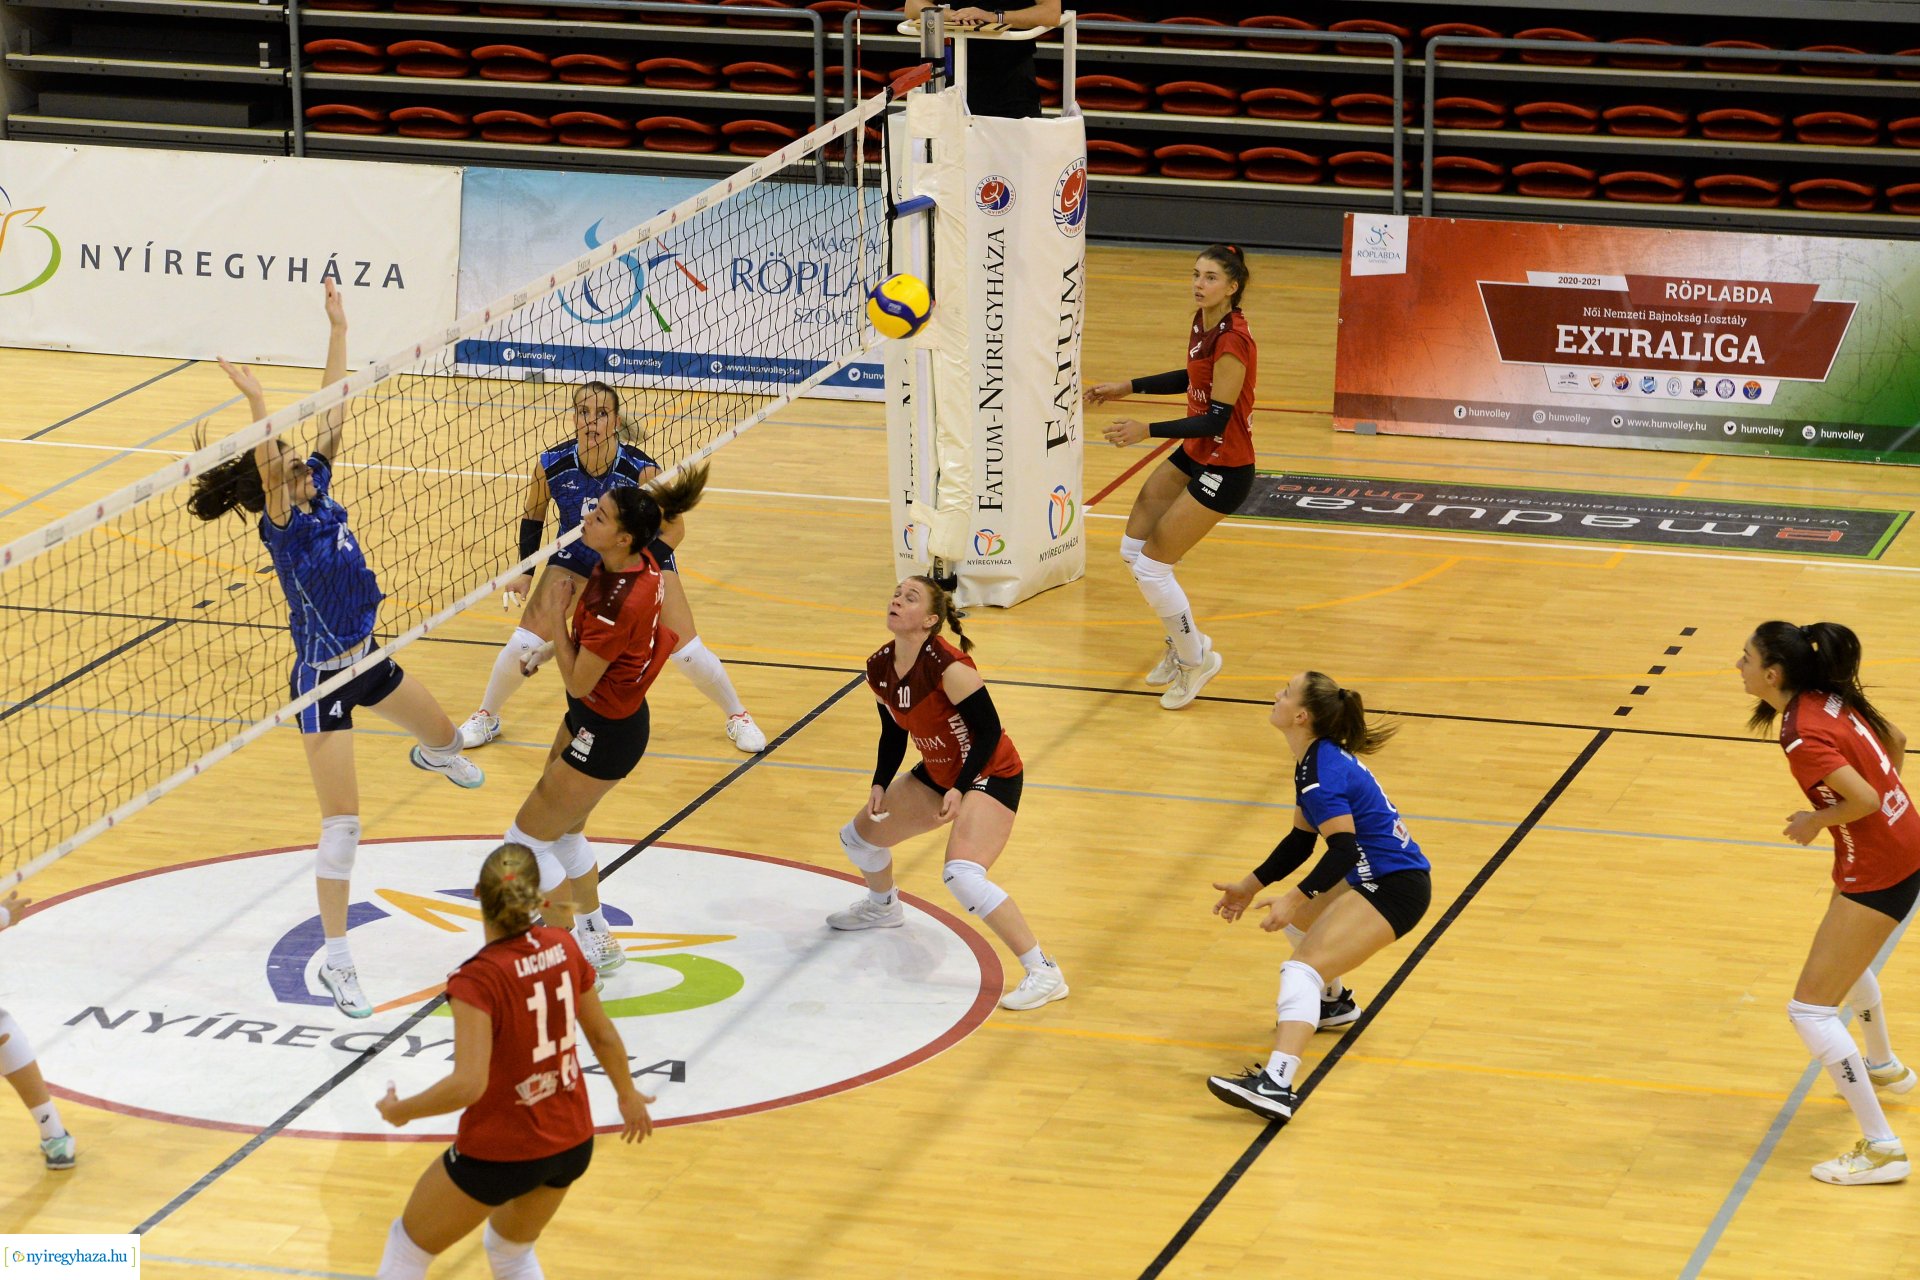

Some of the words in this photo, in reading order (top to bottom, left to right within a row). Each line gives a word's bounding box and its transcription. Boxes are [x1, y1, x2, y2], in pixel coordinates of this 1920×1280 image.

[80, 240, 405, 290] NYÍREGYHÁZA
[1557, 275, 1601, 286] 2020-2021
[1665, 280, 1774, 305] RÖPLABDA
[1583, 306, 1601, 317] Női
[1603, 308, 1646, 321] Nemzeti
[1648, 310, 1702, 325] Bajnokság
[1704, 314, 1747, 327] I.osztály
[1555, 323, 1765, 365] EXTRALIGA
[516, 350, 557, 363] hunvolley
[622, 356, 664, 368] hunvolley
[1046, 261, 1079, 458] FATUM
[1468, 407, 1511, 420] hunvolley
[1548, 412, 1591, 425] hunvolley
[1627, 417, 1707, 433] www.hunvolley.hu
[1740, 424, 1784, 437] hunvolley
[1820, 429, 1865, 442] hunvolley
[1277, 483, 1425, 502] Online
[1038, 536, 1080, 563] NYÍREGYHÁZA
[967, 558, 1012, 566] NYÍREGYHÁZA
[897, 685, 911, 708] 10
[328, 700, 344, 718] 4
[570, 750, 588, 762] JAKO
[526, 971, 578, 1063] 11
